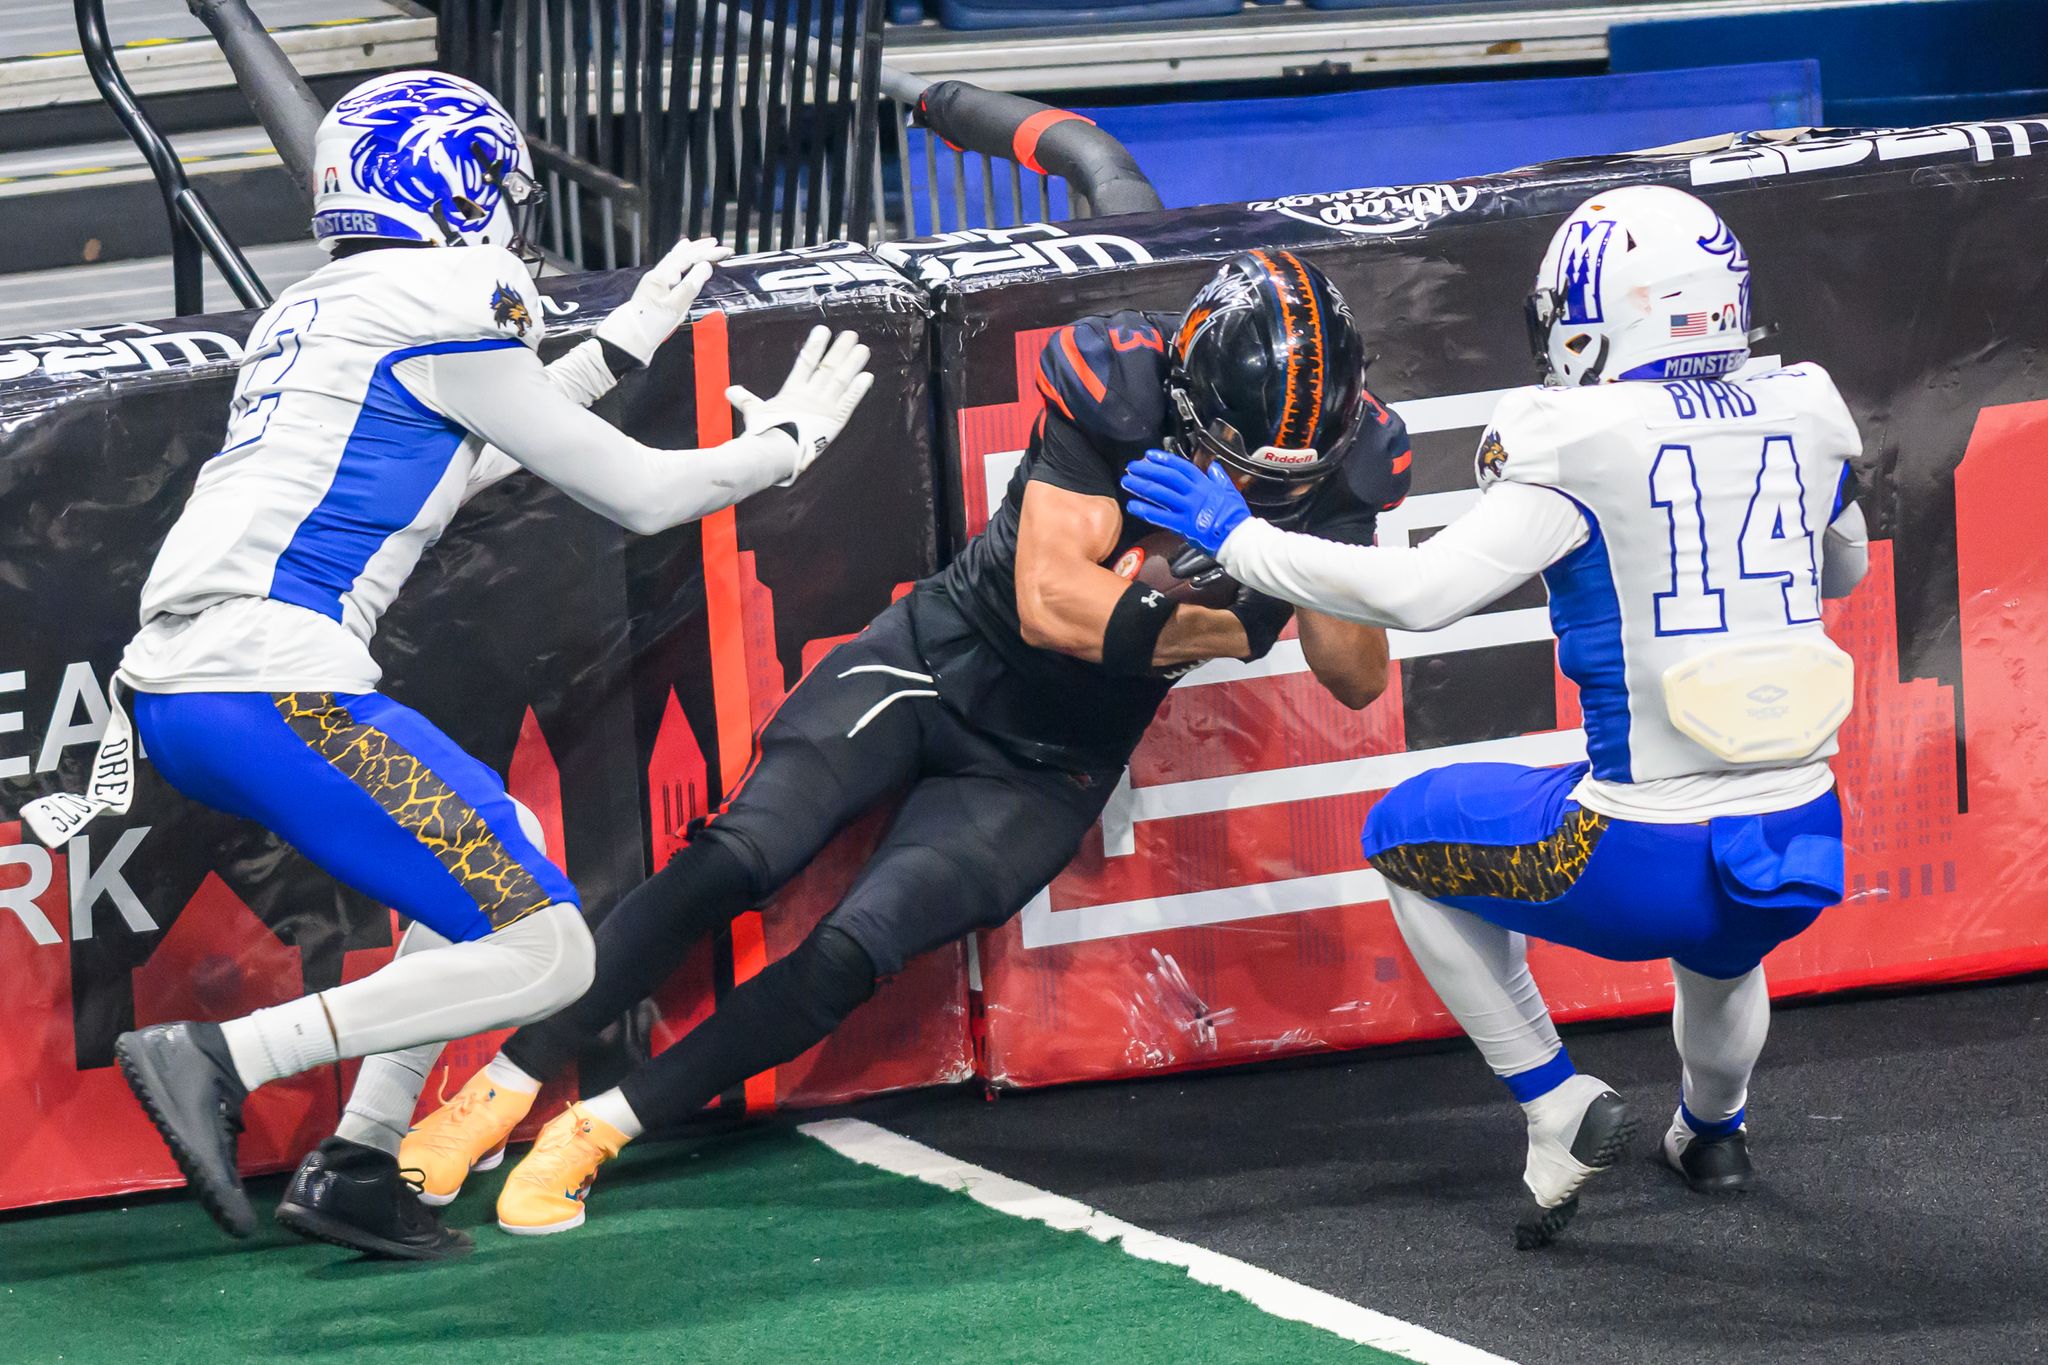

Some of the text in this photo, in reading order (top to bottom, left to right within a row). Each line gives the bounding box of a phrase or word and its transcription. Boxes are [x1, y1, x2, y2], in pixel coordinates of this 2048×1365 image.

[1662, 380, 1757, 420] BYRD
[1264, 452, 1314, 463] Riddell
[1648, 435, 1823, 638] 14
